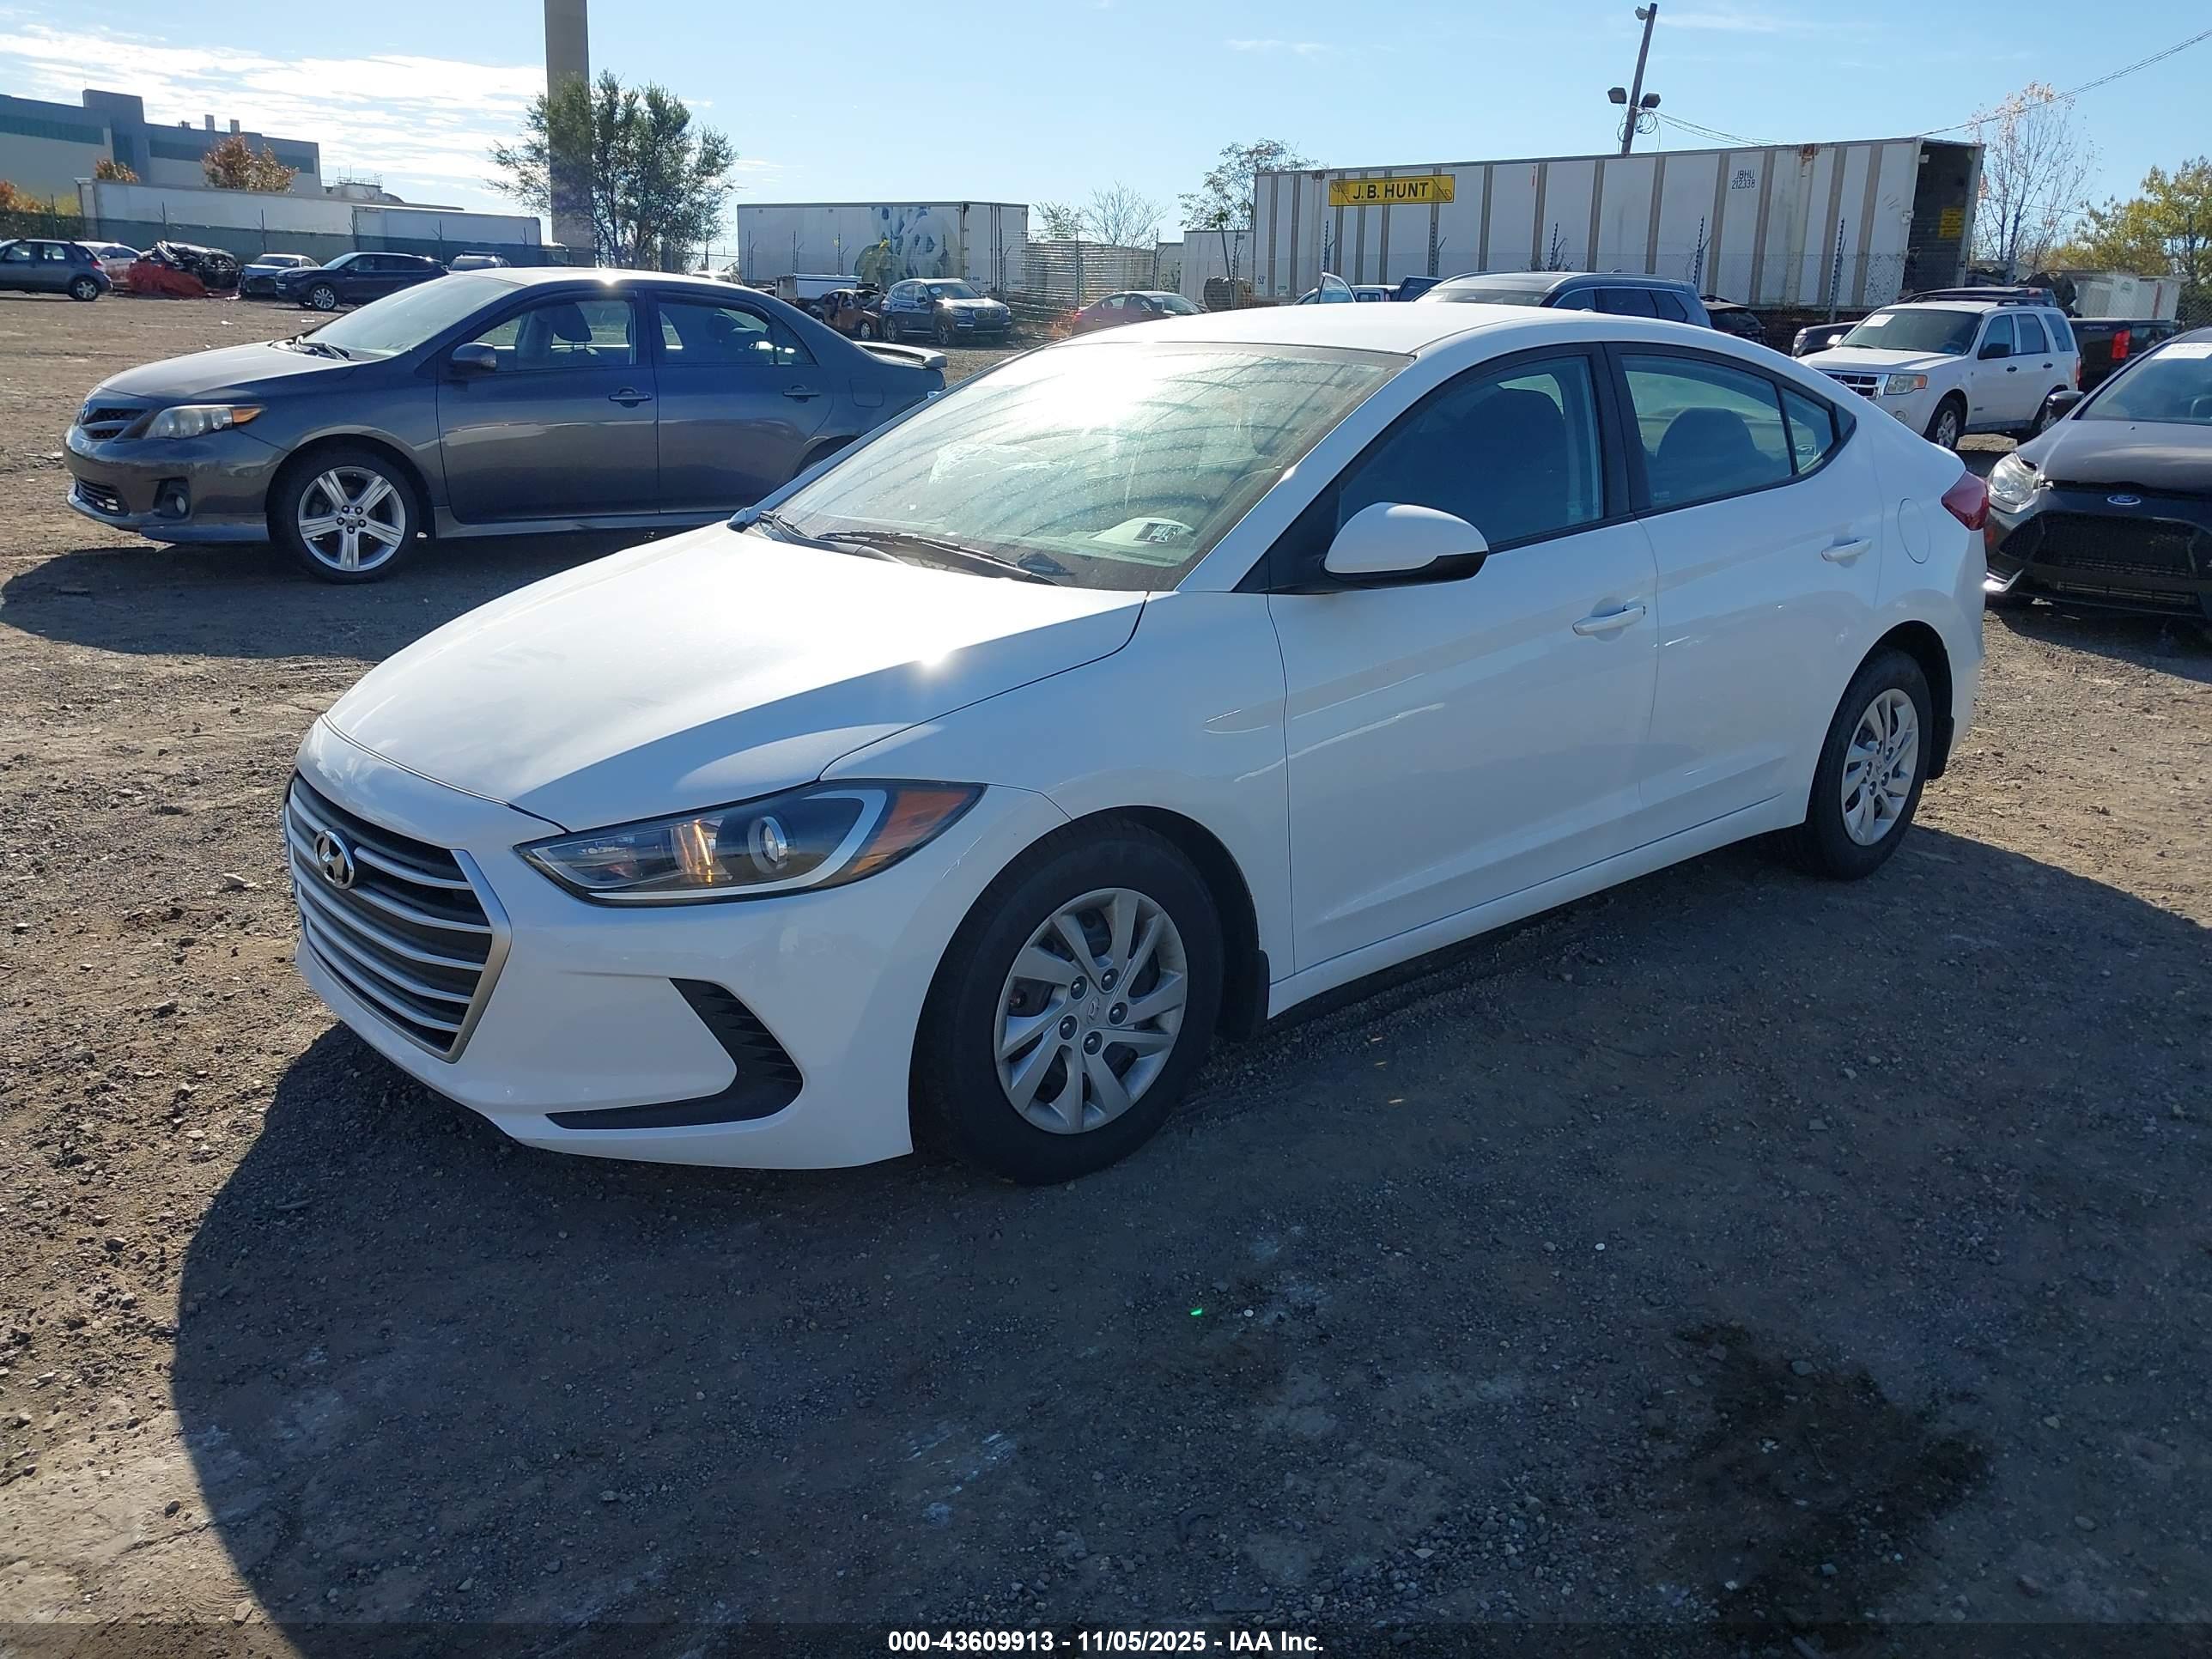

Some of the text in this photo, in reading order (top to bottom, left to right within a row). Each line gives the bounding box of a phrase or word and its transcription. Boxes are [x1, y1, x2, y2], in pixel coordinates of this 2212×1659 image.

[1735, 169, 1754, 179] JBHU
[1353, 182, 1429, 199] J. B. HUNT
